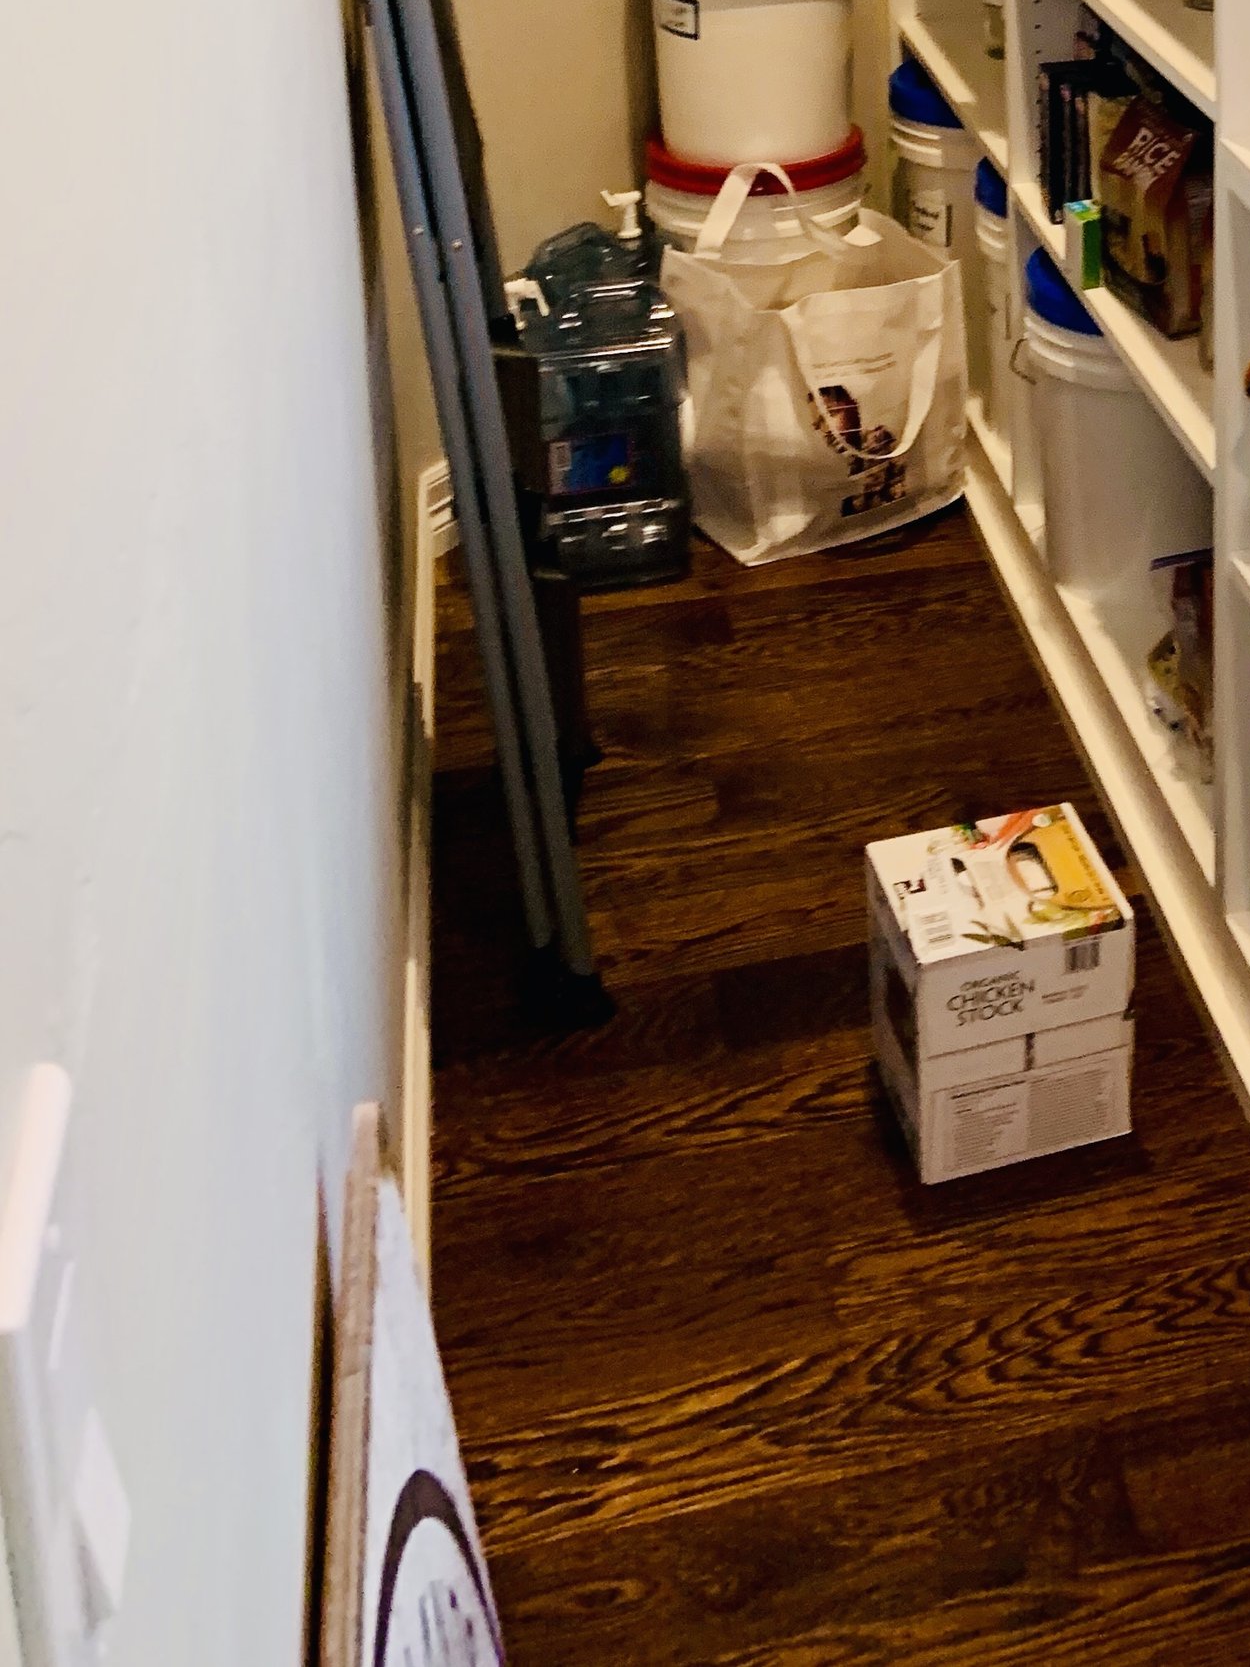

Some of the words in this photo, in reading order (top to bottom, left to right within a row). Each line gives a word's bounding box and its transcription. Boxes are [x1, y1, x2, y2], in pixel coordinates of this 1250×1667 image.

[1127, 126, 1182, 175] RICE
[946, 979, 1036, 1012] CHICKEN
[956, 998, 1024, 1028] STOCK
